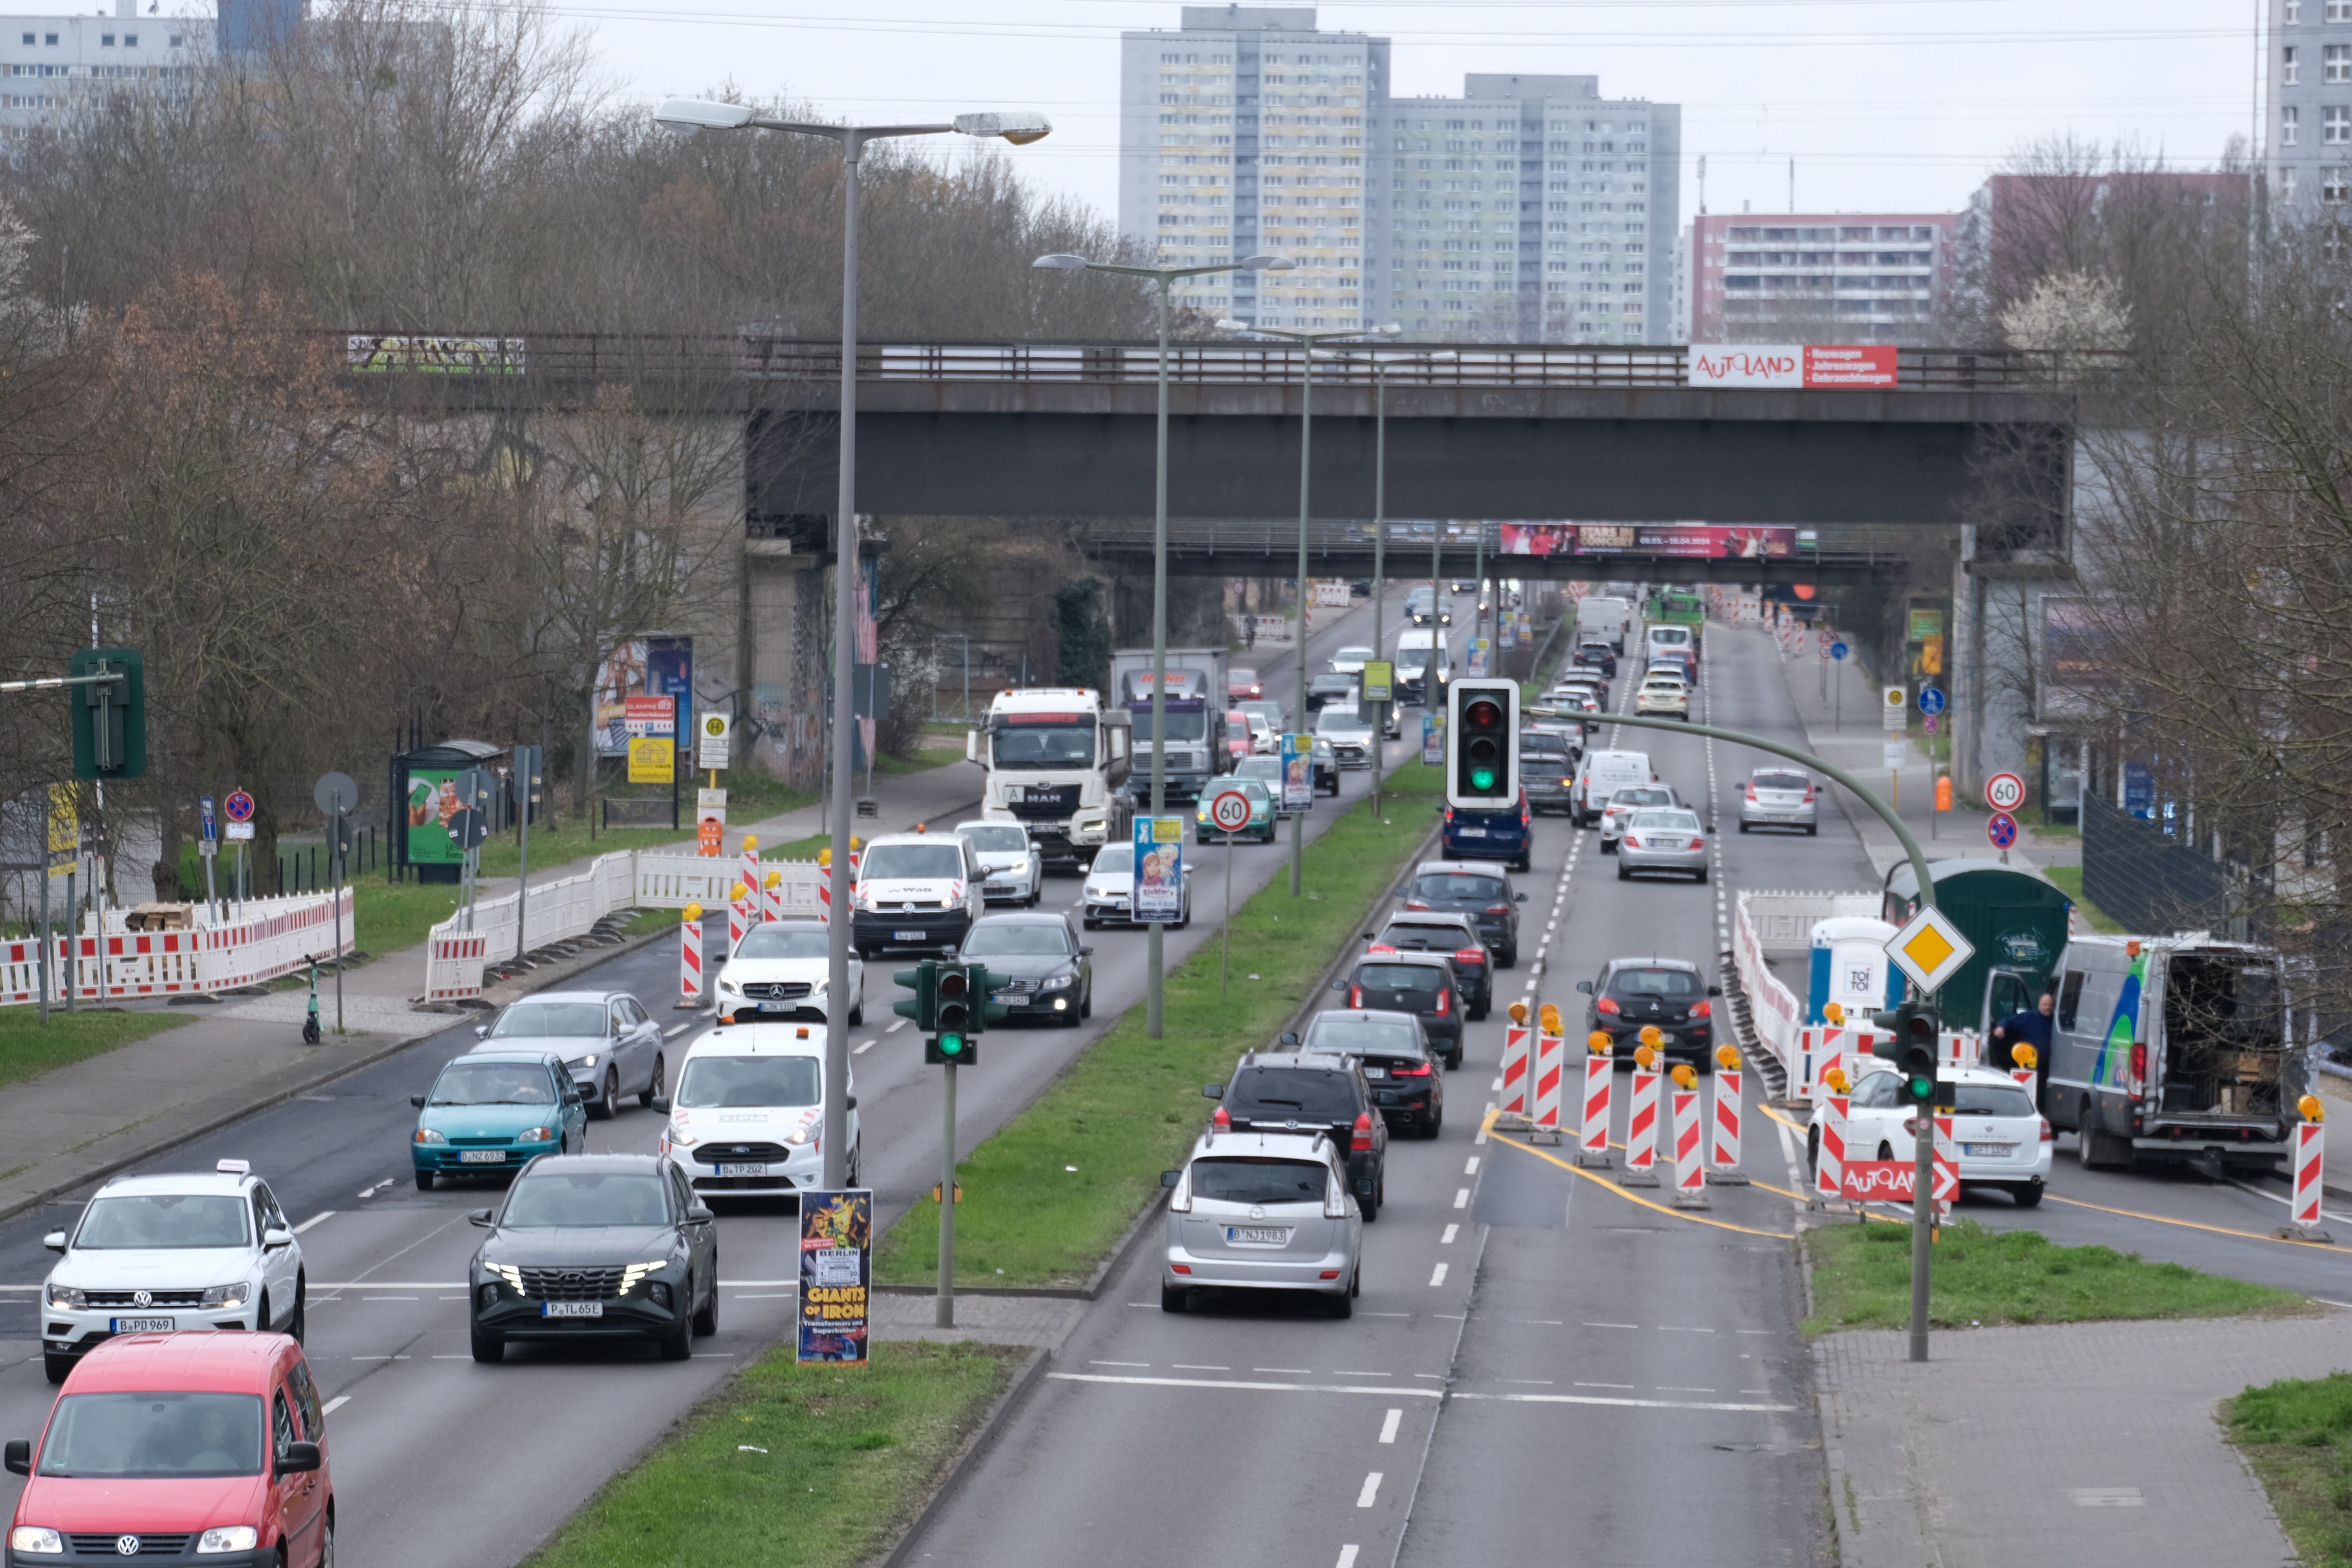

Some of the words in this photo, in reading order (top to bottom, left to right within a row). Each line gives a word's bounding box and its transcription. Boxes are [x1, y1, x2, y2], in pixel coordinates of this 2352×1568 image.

[1813, 350, 1862, 360] Neuwagen
[1697, 353, 1794, 379] AUTOLAND
[1813, 362, 1876, 371] Jahreswagen
[1813, 373, 1891, 384] Gebrauchtwagen
[1009, 789, 1018, 800] A
[1995, 784, 2015, 801] 60
[1027, 794, 1061, 803] MAN
[1220, 802, 1242, 820] 60
[462, 1152, 467, 1161] B
[473, 1152, 483, 1160] NZ
[485, 1152, 504, 1160] 6932
[723, 1166, 728, 1174] B
[747, 1165, 762, 1174] 202
[1234, 1230, 1239, 1239] B
[1246, 1231, 1258, 1240] NJ
[1261, 1232, 1284, 1240] 1983
[808, 1286, 865, 1303] GIANTS
[551, 1304, 557, 1314] P
[565, 1304, 577, 1314] TL
[805, 1305, 821, 1315] OF
[823, 1304, 864, 1319] IRON
[121, 1320, 127, 1331] B
[134, 1320, 147, 1331] PD
[150, 1320, 169, 1331] 969
